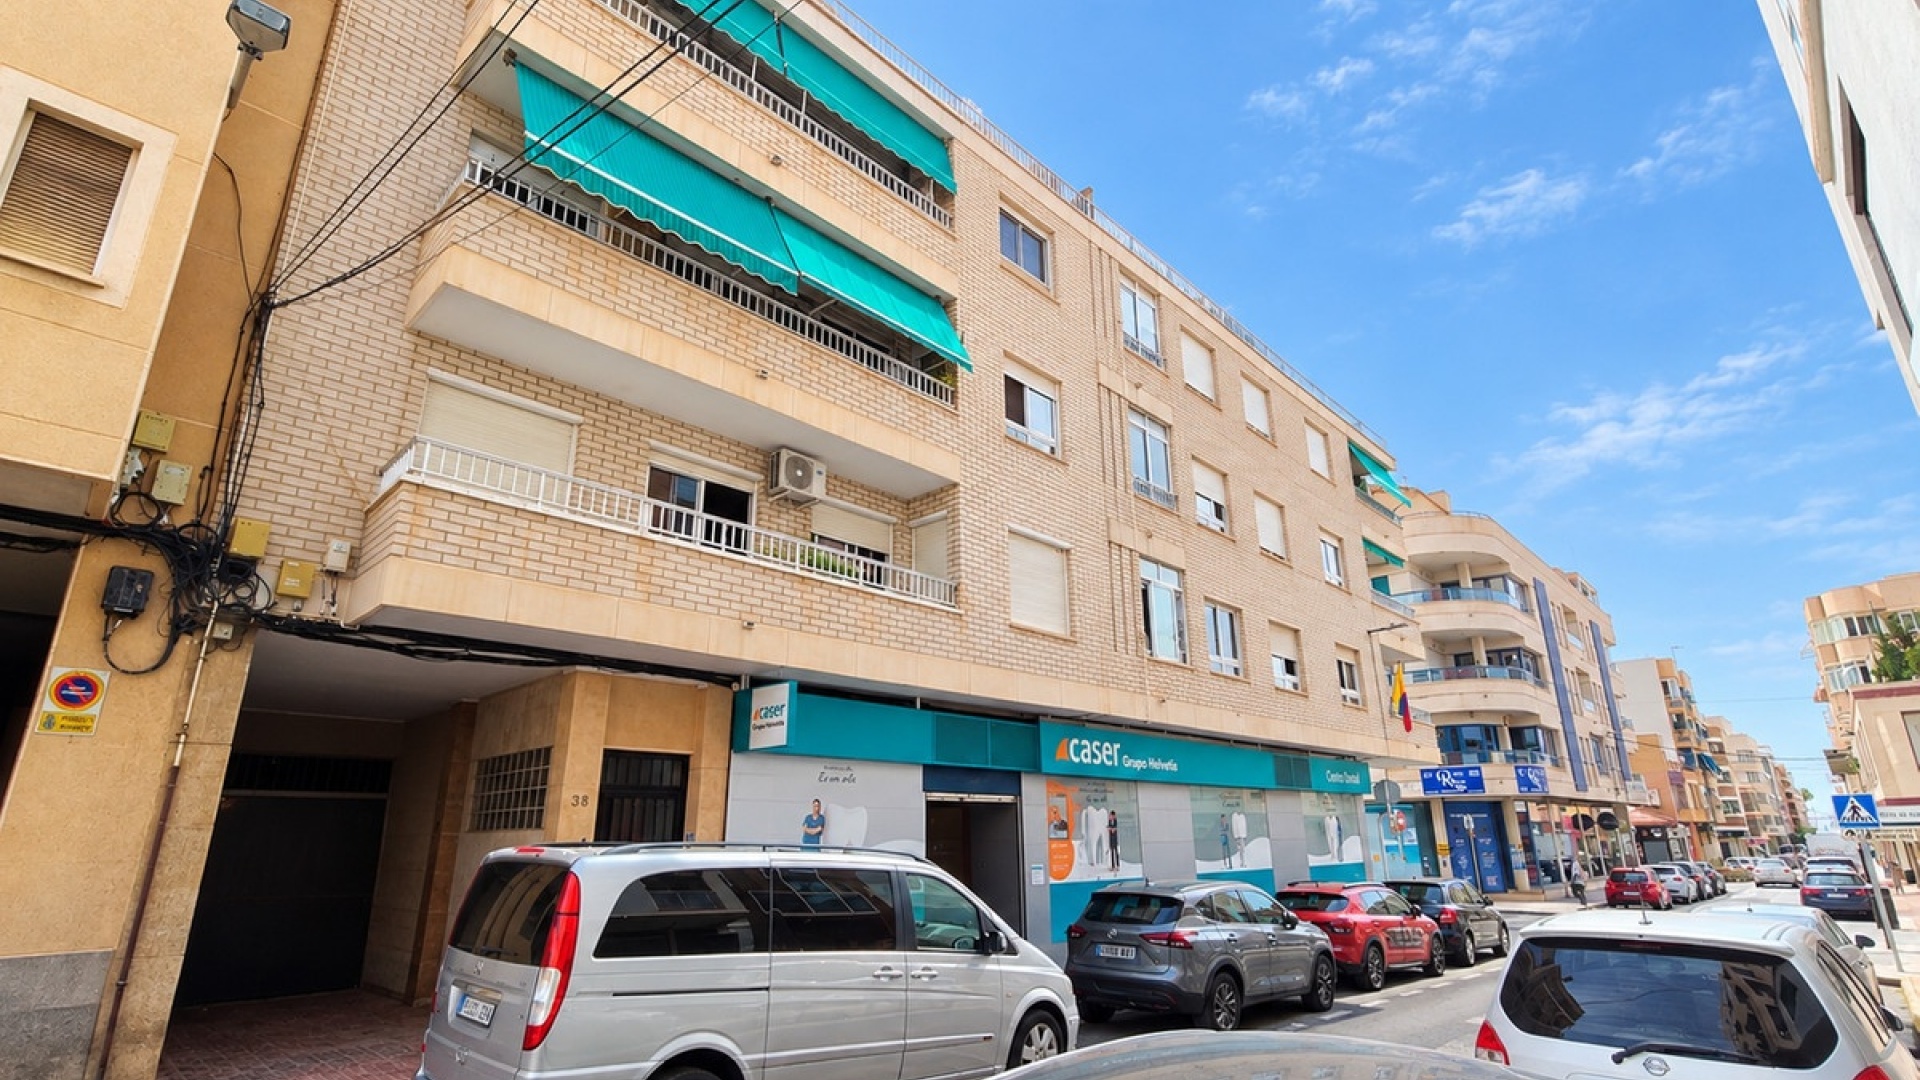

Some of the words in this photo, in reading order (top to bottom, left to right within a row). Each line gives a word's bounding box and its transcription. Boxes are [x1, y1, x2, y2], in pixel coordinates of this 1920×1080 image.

[759, 704, 785, 719] caser
[1069, 737, 1120, 766] caser
[1122, 755, 1147, 770] Grupo
[1148, 757, 1178, 772] Helvetia
[571, 794, 589, 807] 38
